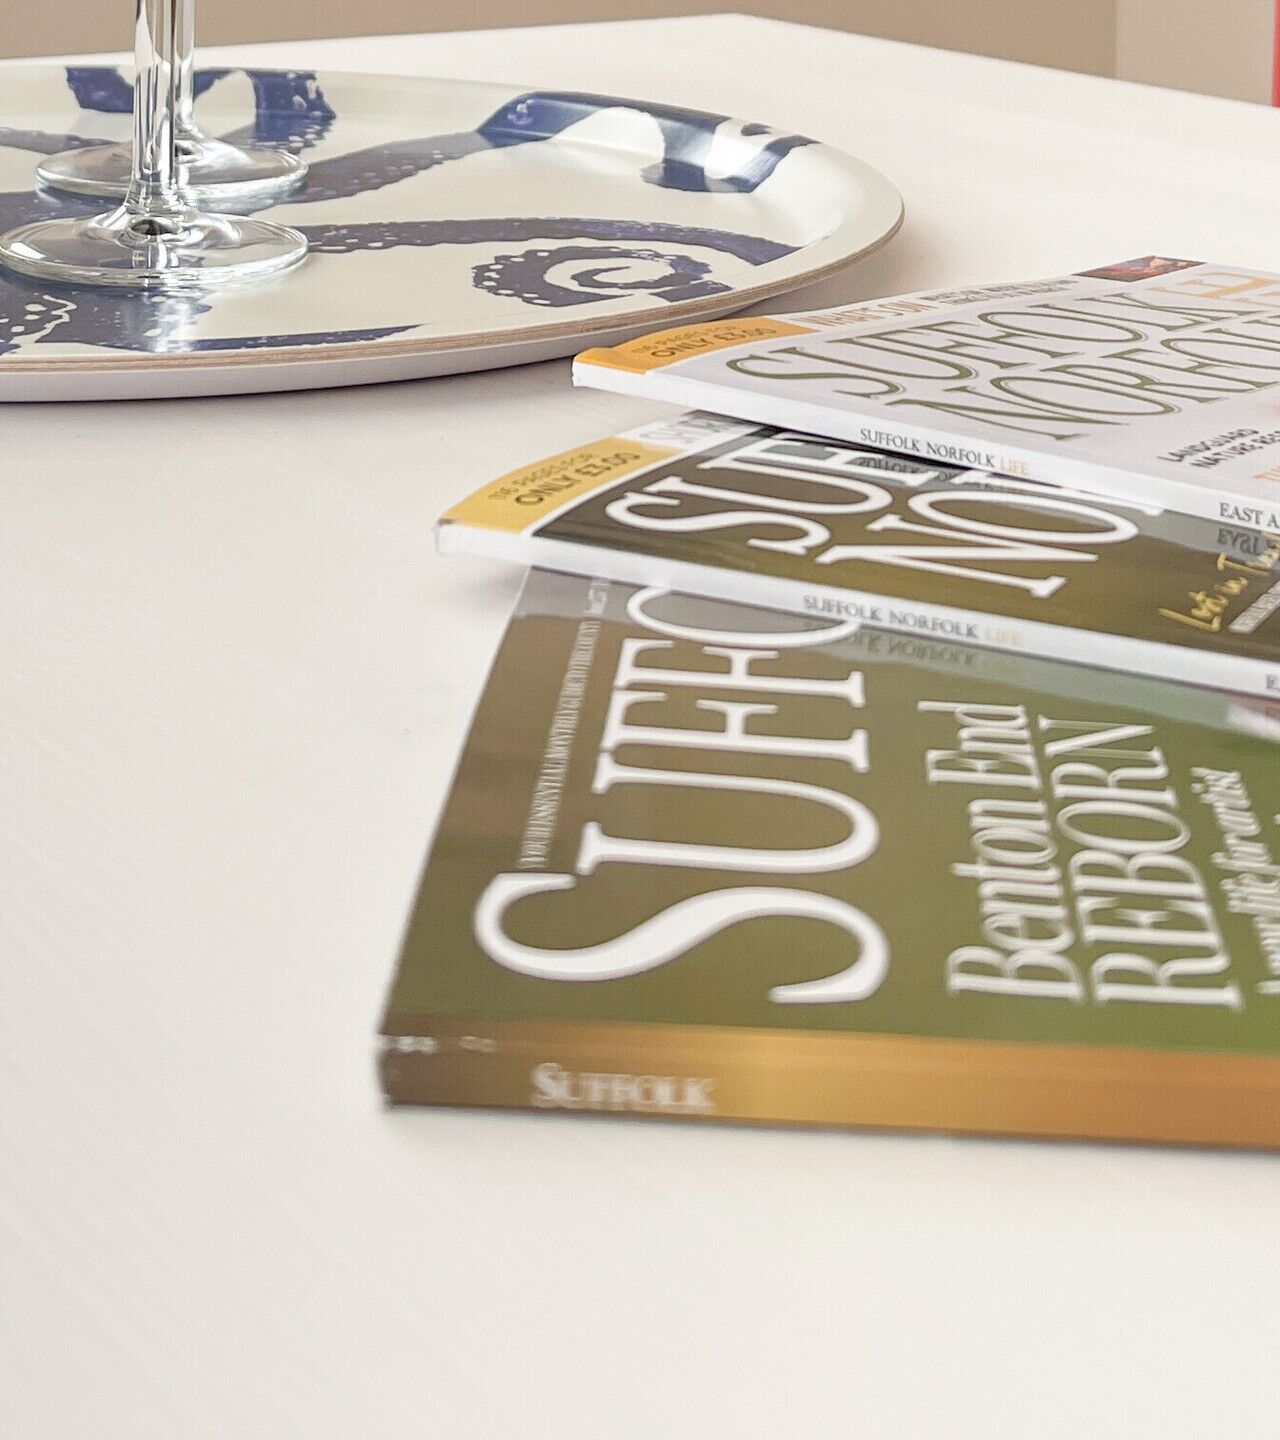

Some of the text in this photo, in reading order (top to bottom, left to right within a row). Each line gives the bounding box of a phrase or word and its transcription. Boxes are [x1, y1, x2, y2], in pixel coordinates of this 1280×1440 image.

[650, 336, 712, 358] ONLY
[725, 293, 1266, 398] SUFFOLK
[860, 428, 1029, 476] SUFFOLK NORFOLK LIFE
[1157, 428, 1259, 462] LANDGUARD
[1190, 444, 1263, 468] NATURE
[515, 474, 582, 506] ONLY
[606, 430, 945, 556] SUF
[1219, 501, 1263, 526] EAST
[803, 594, 883, 622] SUFFOLK
[889, 608, 979, 640] NORFOLK
[474, 586, 891, 1005] SUFFO
[1190, 765, 1262, 836] artist
[917, 698, 1088, 1003] Benton End
[1038, 713, 1243, 1012] REBORN
[531, 1061, 717, 1110] SUFFOLK
